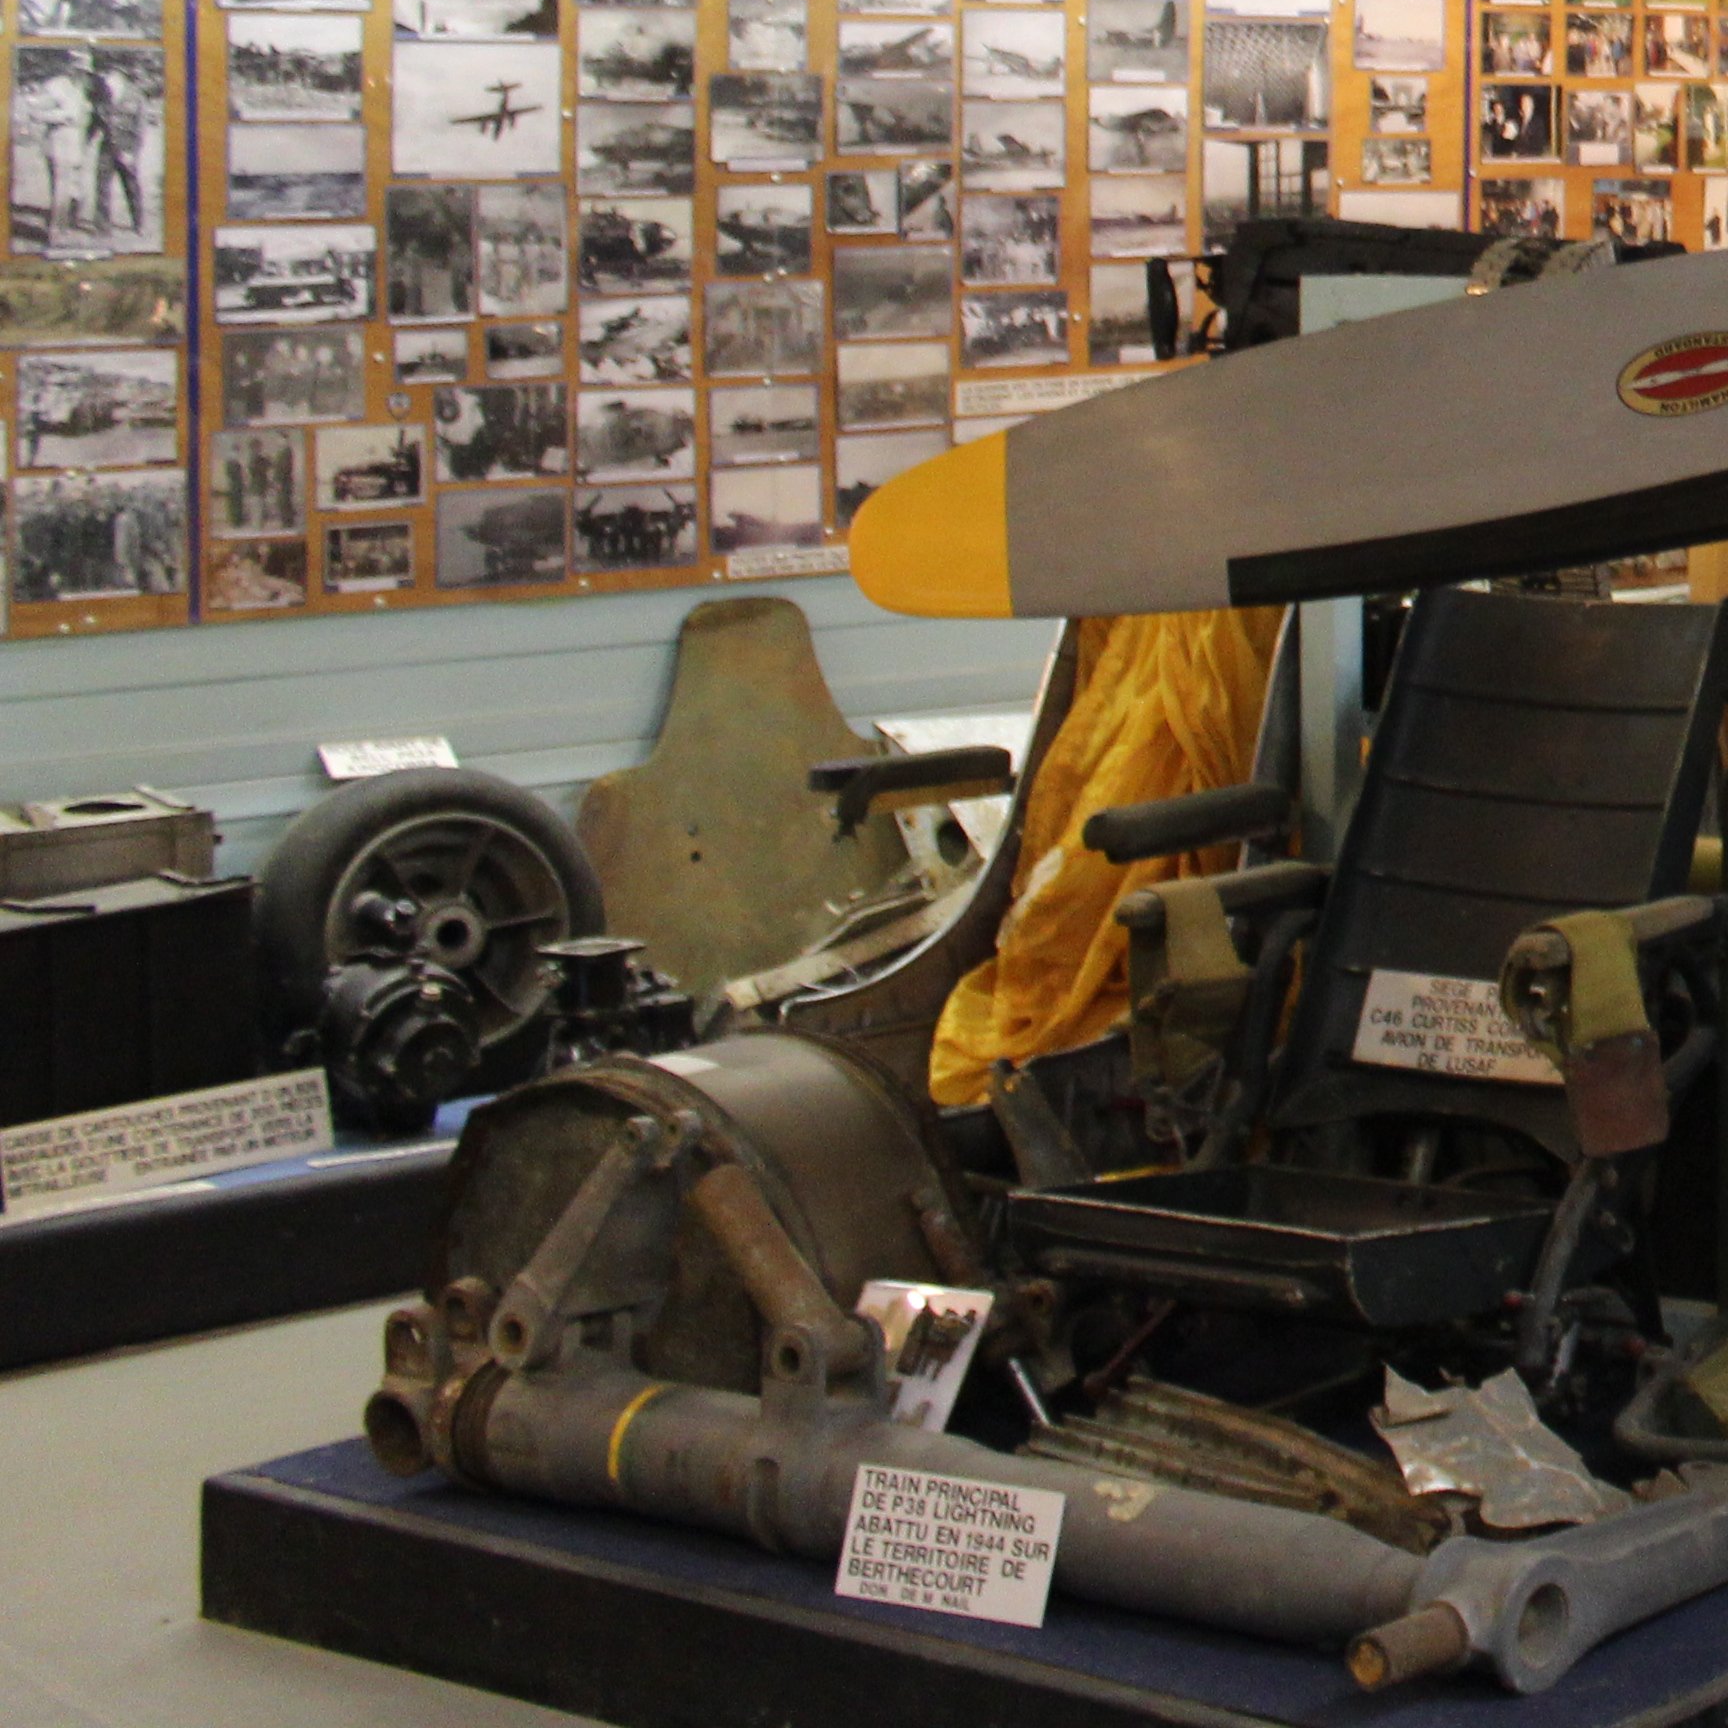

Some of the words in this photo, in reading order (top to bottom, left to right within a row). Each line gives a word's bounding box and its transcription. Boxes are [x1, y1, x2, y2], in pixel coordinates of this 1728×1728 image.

[1412, 995, 1498, 1018] PROVENAN
[865, 1470, 922, 1495] TRAIN
[925, 1480, 1022, 1513] PRINCIPAL
[862, 1492, 887, 1511] DE
[892, 1495, 927, 1517] P38
[933, 1503, 1036, 1535] LIGHTNING
[850, 1537, 876, 1556] LE
[882, 1540, 991, 1575] TERRITOIRE
[1001, 1559, 1028, 1580] DE
[856, 1514, 929, 1541] ABATTU
[935, 1526, 961, 1547] EN
[965, 1533, 1006, 1553] 1944
[1010, 1539, 1050, 1562] SUR
[848, 1558, 988, 1598] BERTHECOURT
